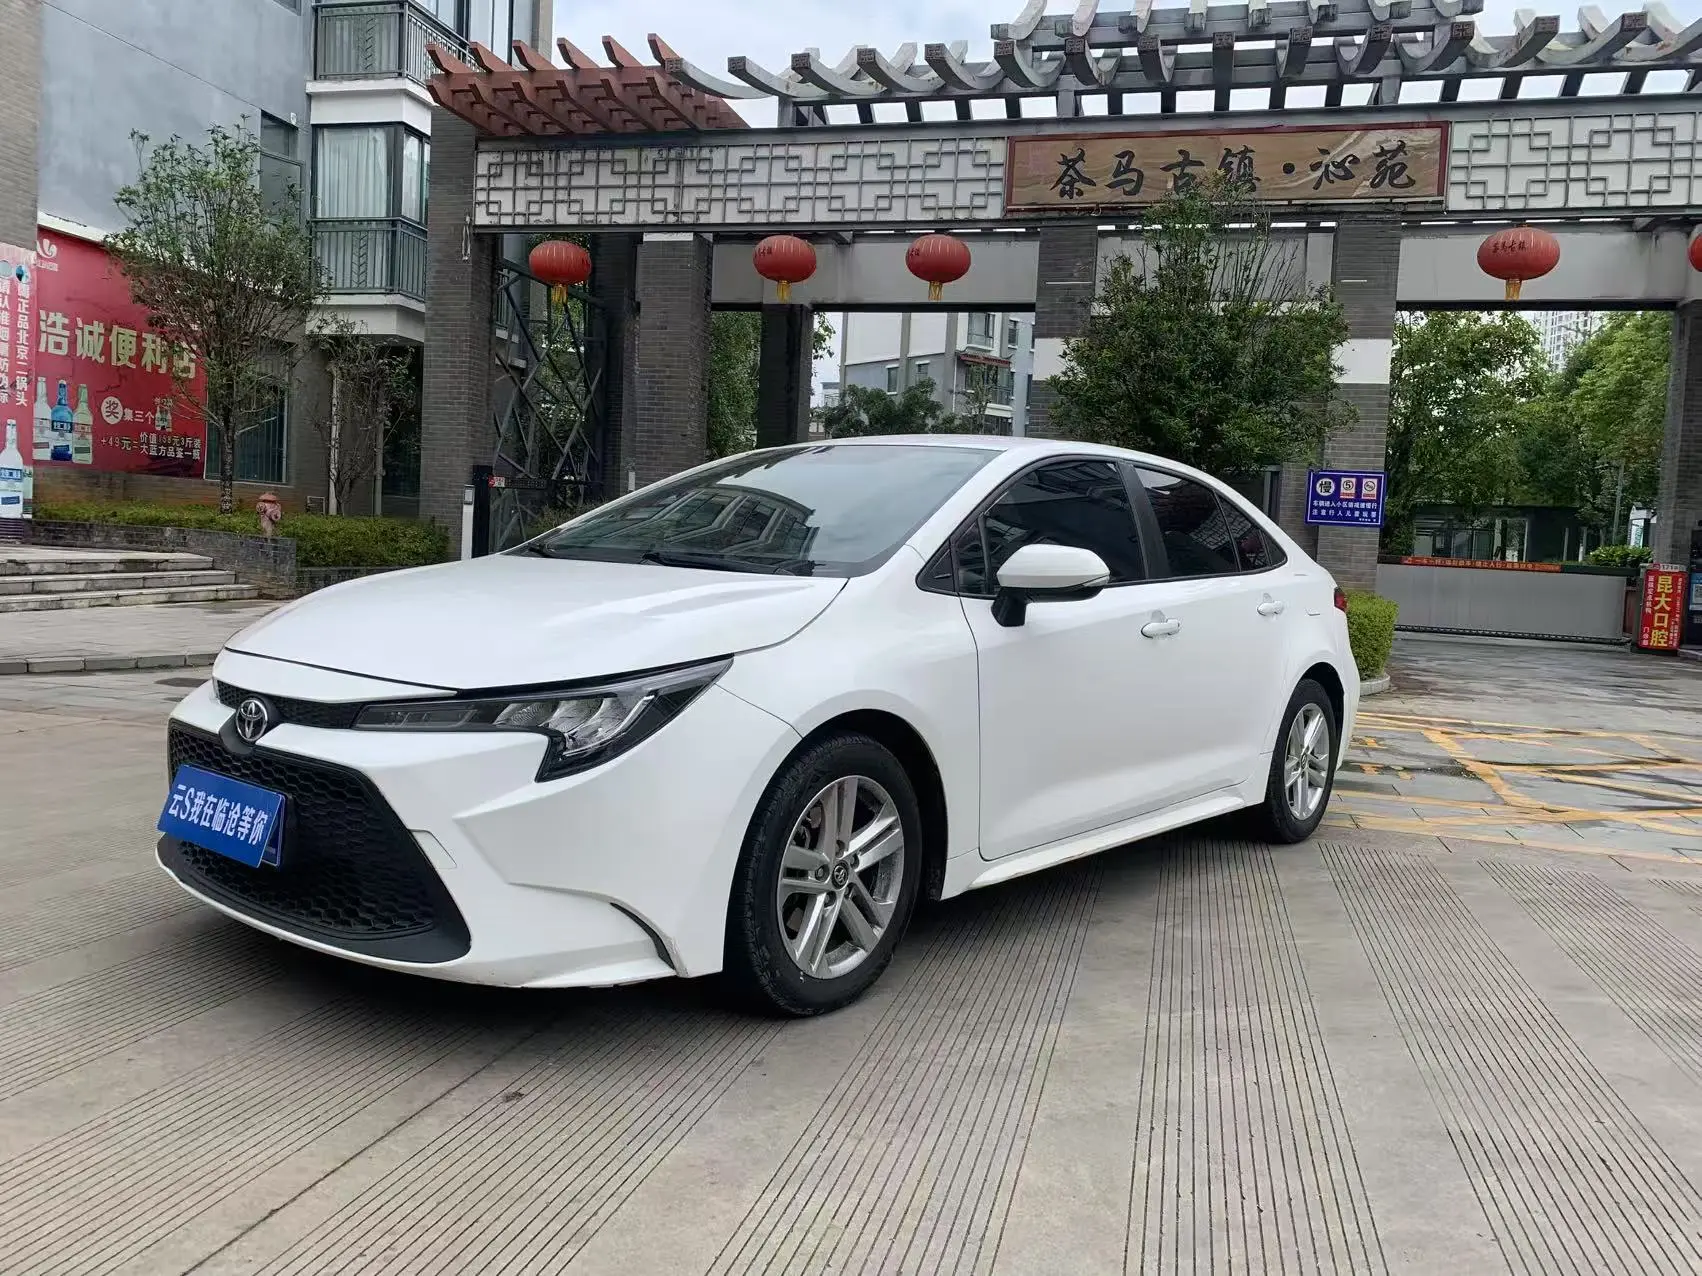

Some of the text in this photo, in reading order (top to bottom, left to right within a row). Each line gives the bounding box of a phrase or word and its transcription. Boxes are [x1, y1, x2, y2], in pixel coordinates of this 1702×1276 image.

[38, 310, 196, 379] 浩诚便利店
[1650, 575, 1673, 647] 昆大口腔
[168, 784, 269, 846] 云S我在临沧等你
